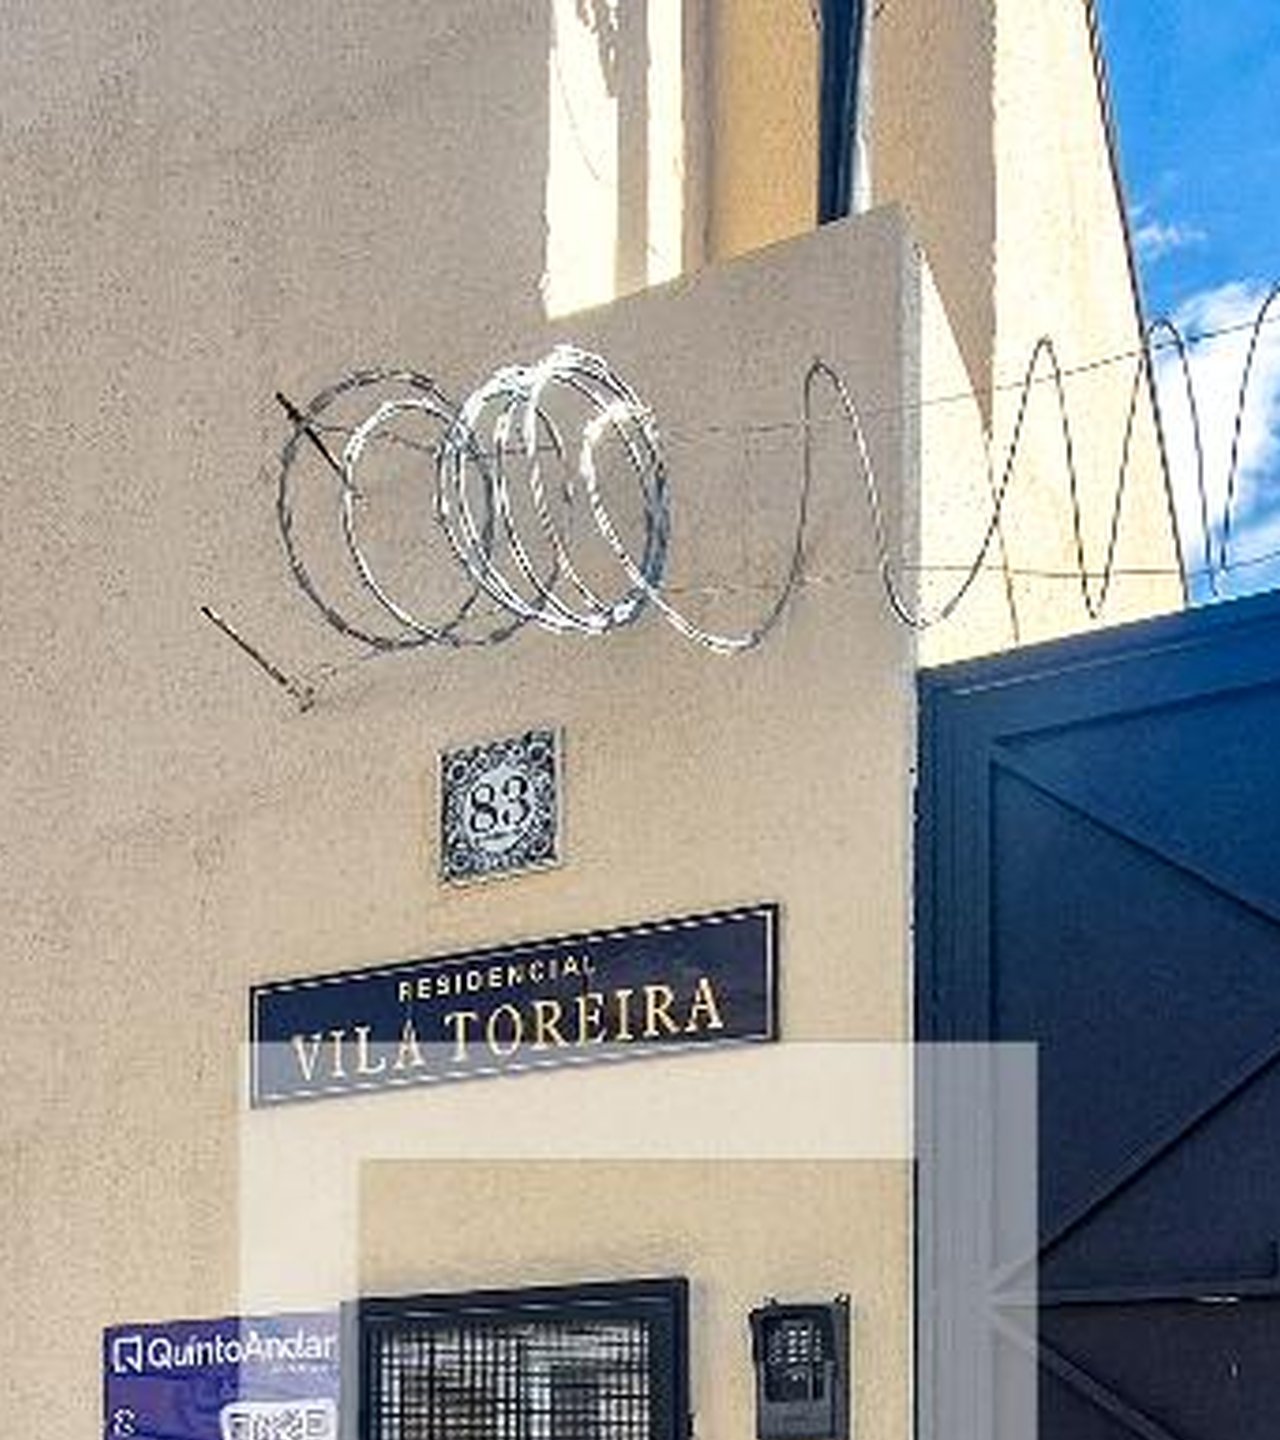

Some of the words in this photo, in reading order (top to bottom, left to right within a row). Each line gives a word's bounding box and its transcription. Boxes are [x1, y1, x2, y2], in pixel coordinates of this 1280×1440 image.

[470, 775, 531, 832] 83
[399, 954, 596, 1002] RESIDENCIAL
[291, 1020, 426, 1081] VILA
[444, 976, 724, 1063] TOREIRA
[147, 1327, 337, 1370] QuintoAndar
